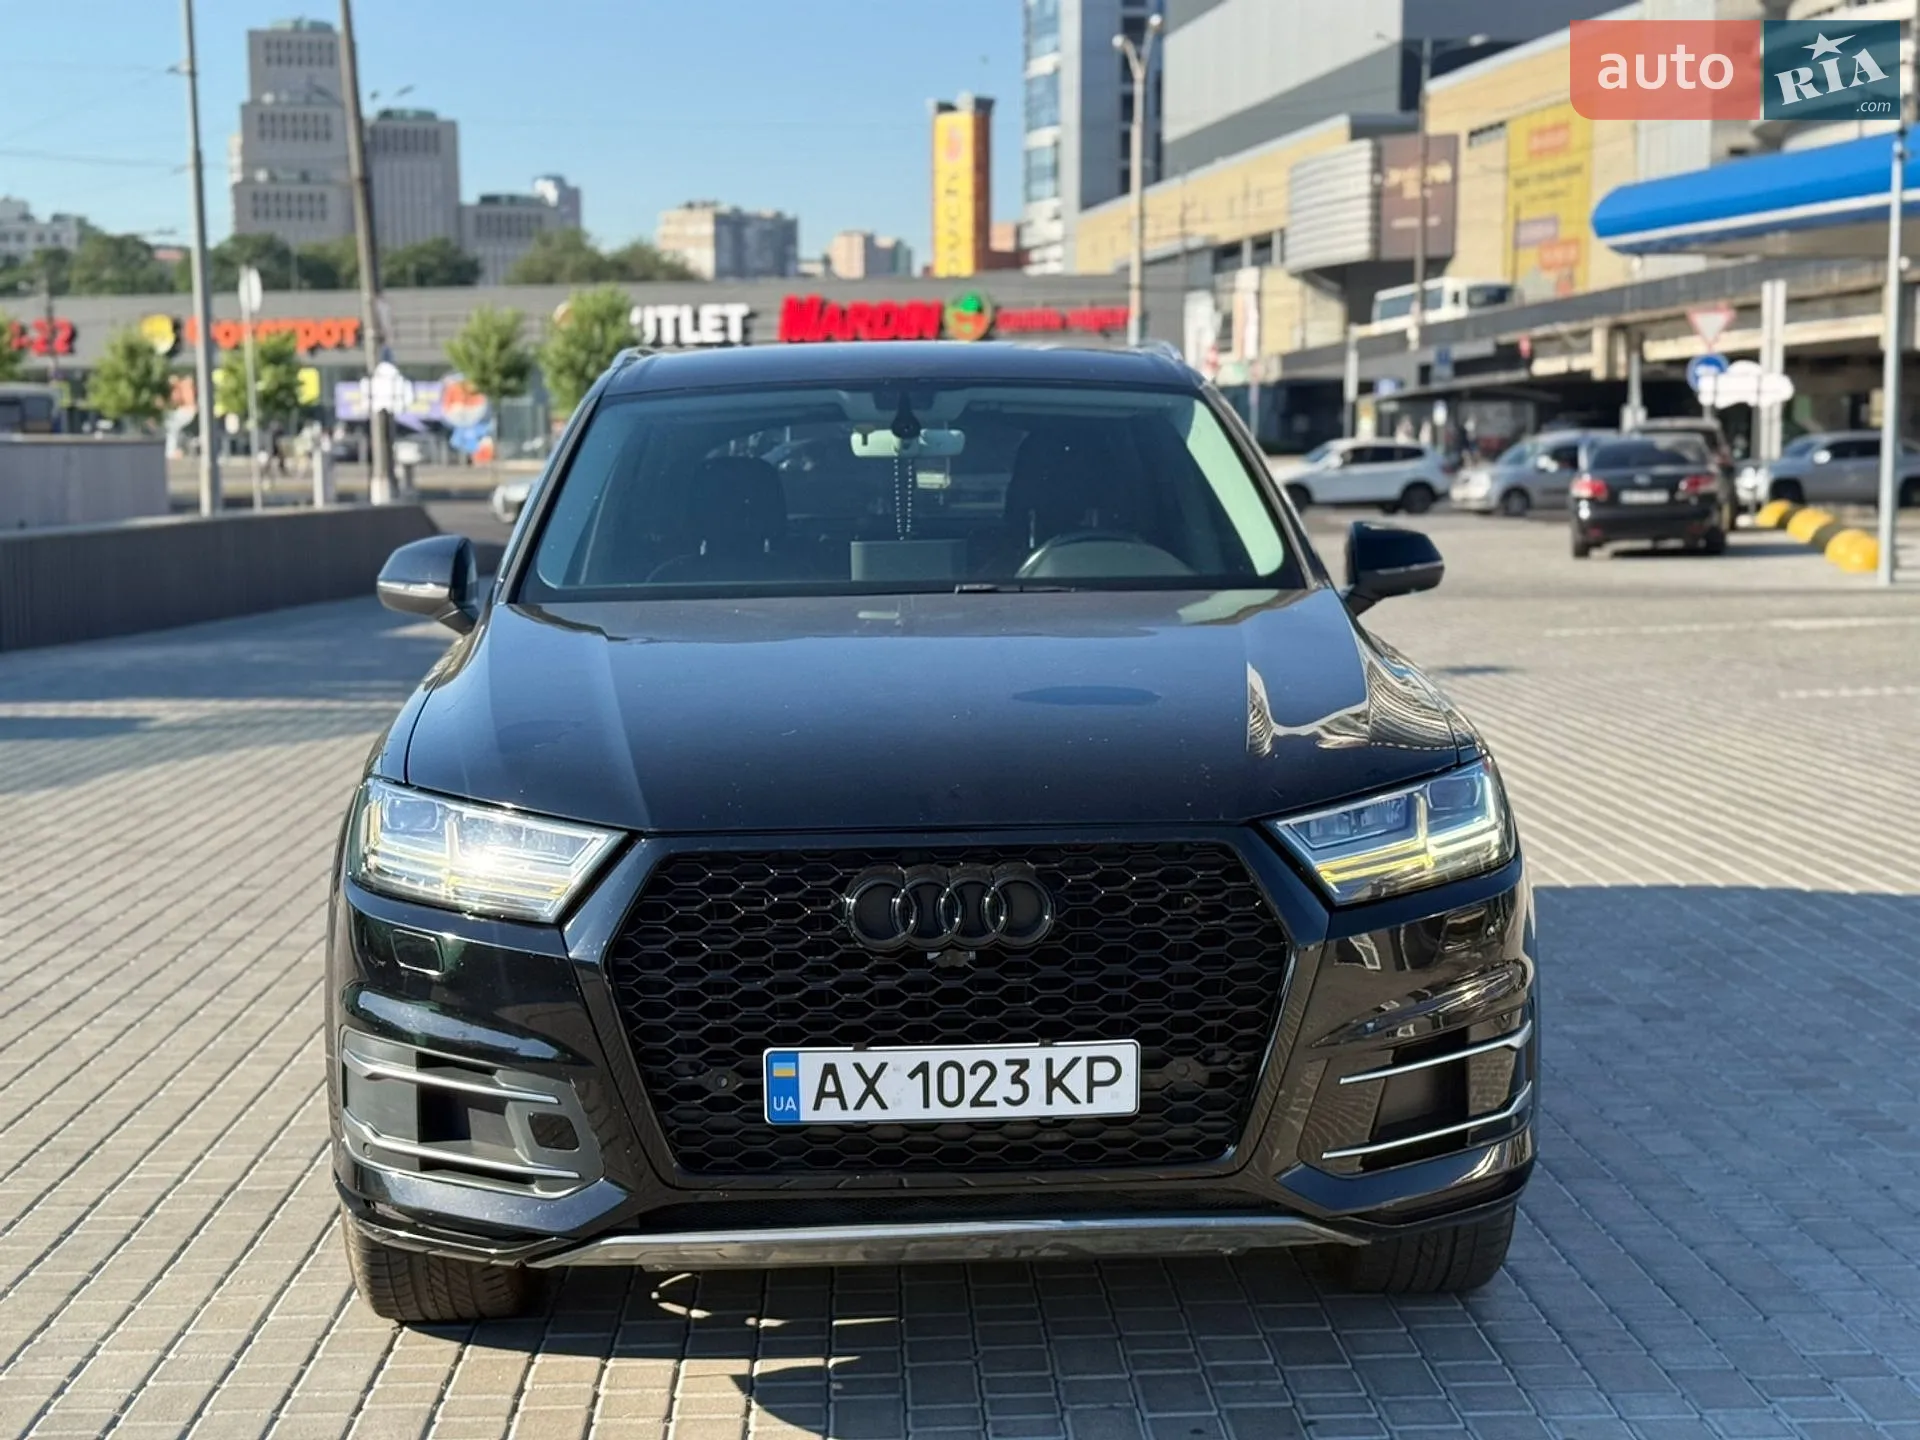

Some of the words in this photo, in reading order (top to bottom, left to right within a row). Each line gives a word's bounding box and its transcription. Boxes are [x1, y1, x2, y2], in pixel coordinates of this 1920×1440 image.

[629, 303, 750, 344] UTLET
[773, 1095, 796, 1111] UA
[812, 1061, 889, 1112] AX
[906, 1057, 1032, 1109] 1023
[1044, 1055, 1123, 1106] KP
